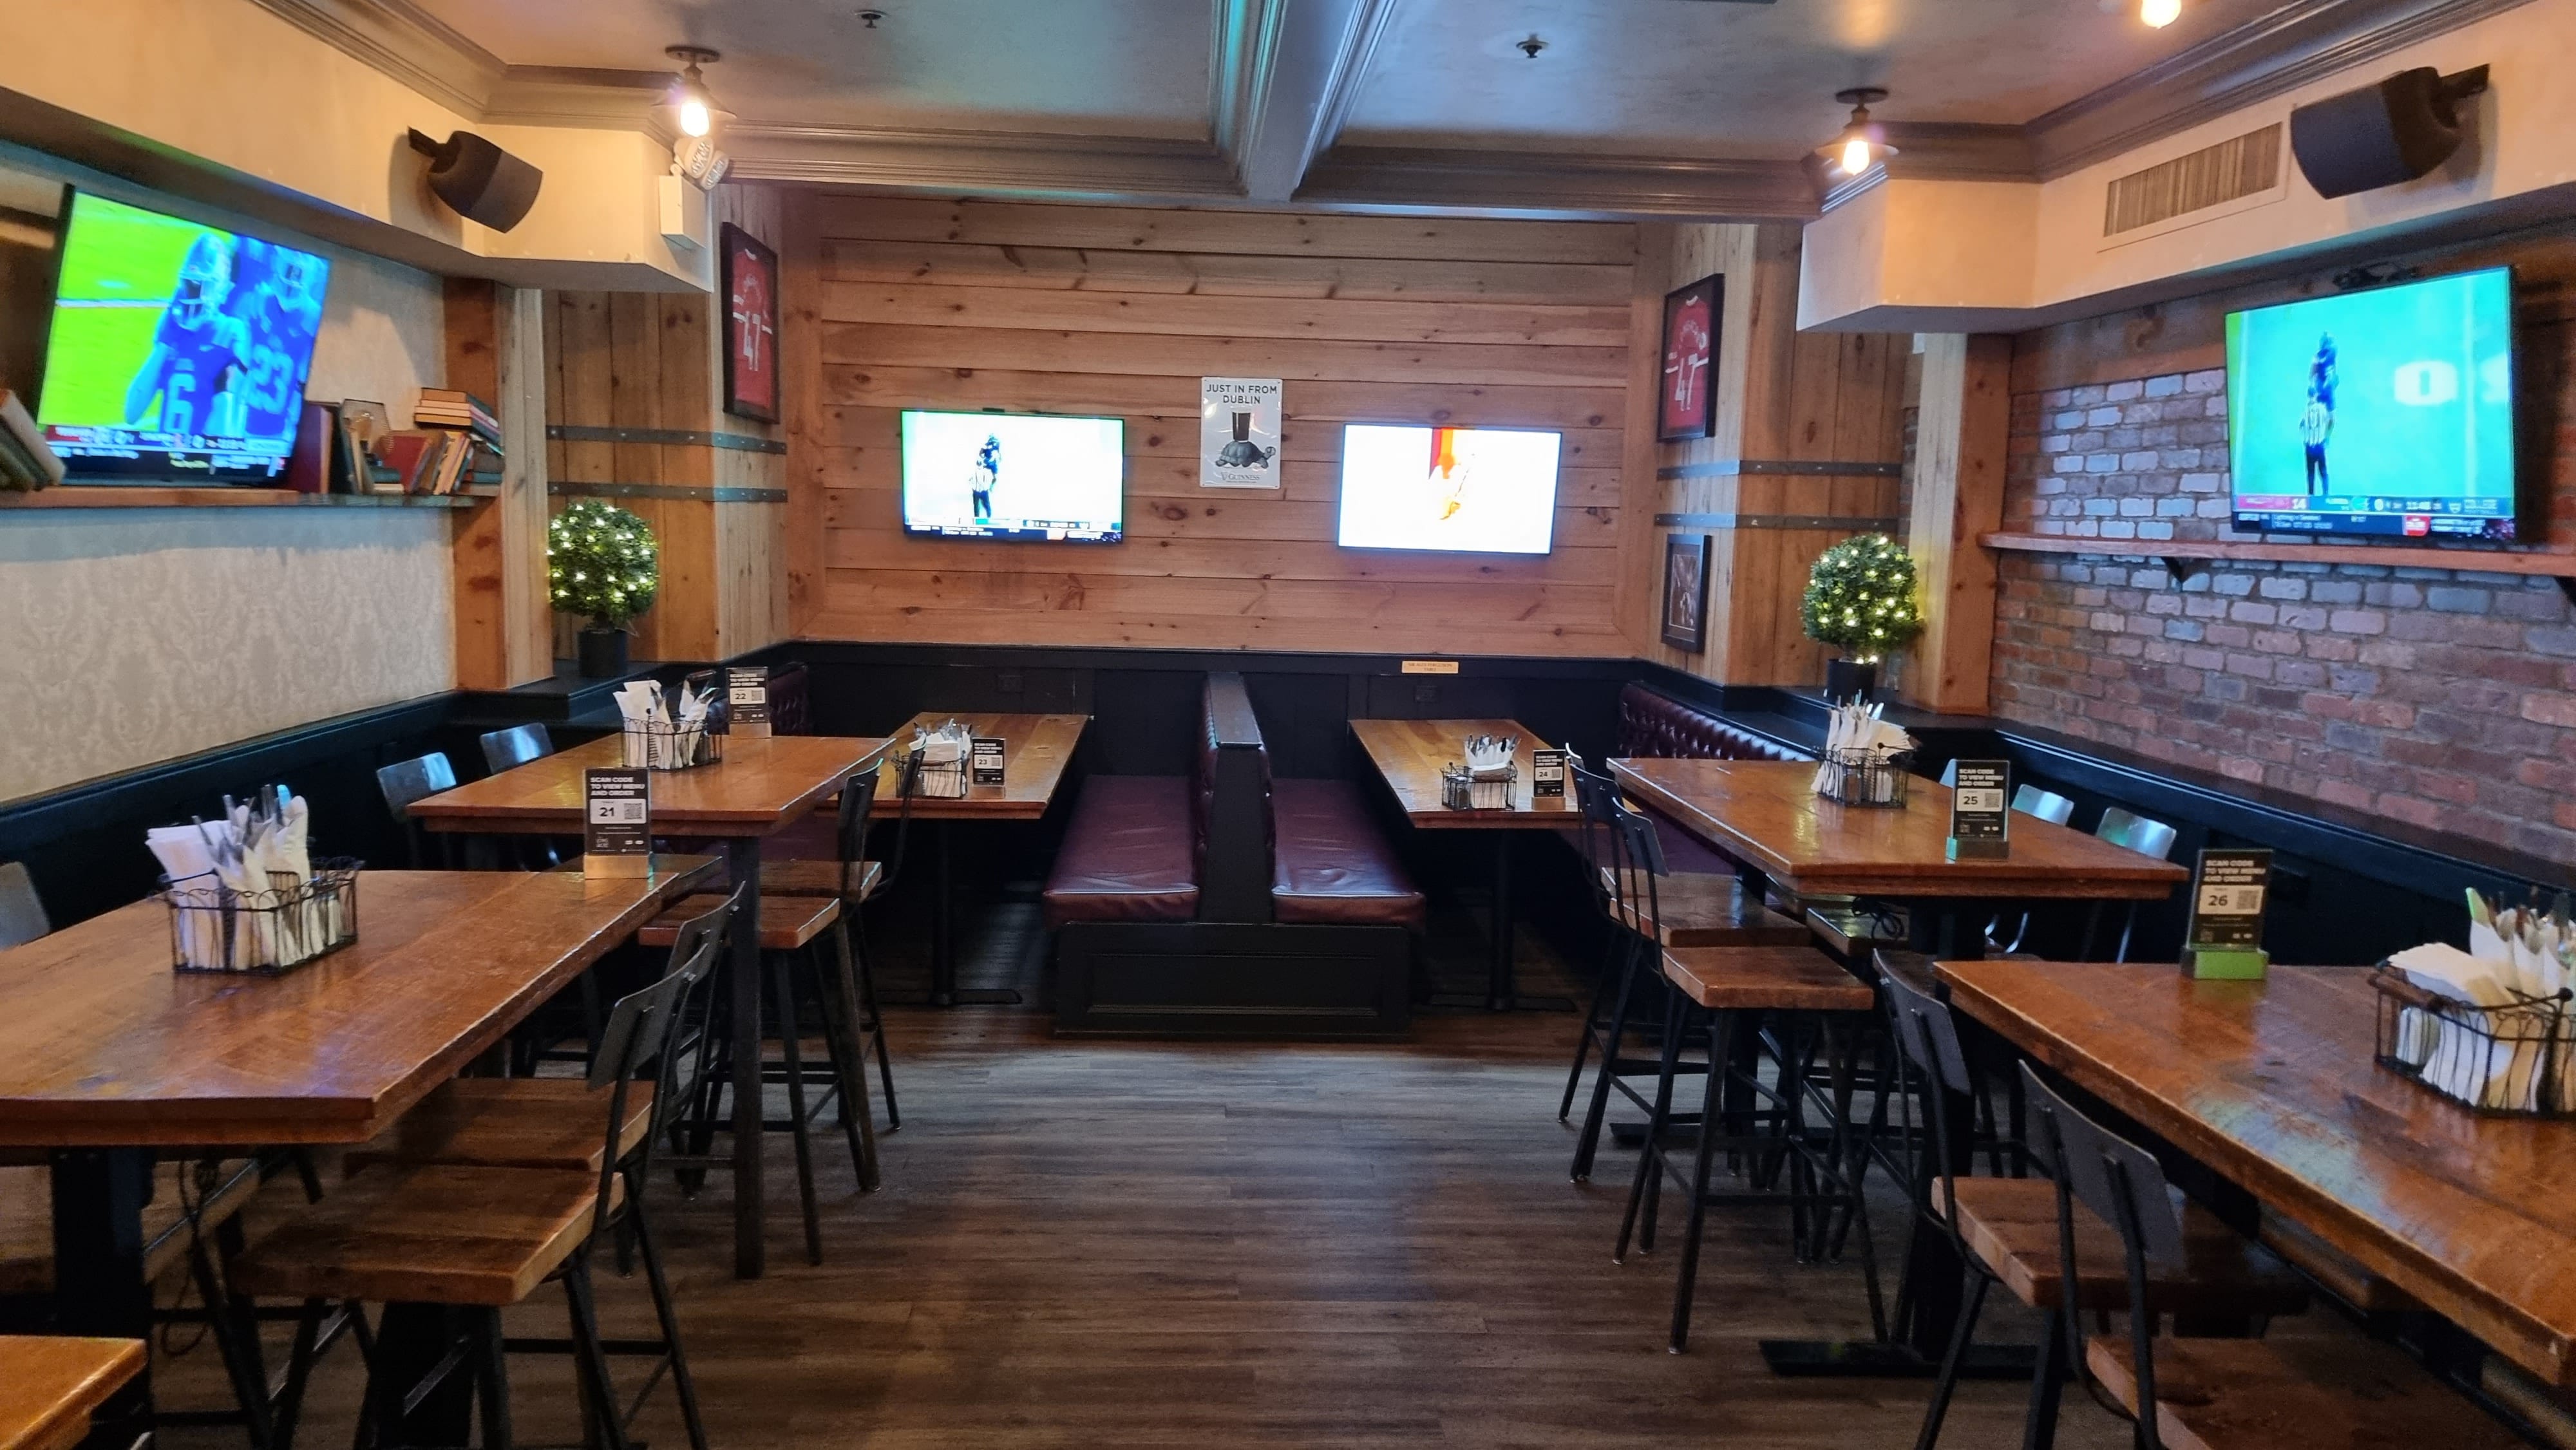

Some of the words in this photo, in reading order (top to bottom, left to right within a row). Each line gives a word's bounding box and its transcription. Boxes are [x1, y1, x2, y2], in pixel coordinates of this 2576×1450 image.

[1206, 384, 1231, 393] JUST
[1235, 385, 1245, 393] IN
[1248, 386, 1277, 394] FROM
[163, 373, 196, 433] 6
[1223, 395, 1260, 404] DUBLIN
[1964, 796, 1978, 805] 25
[599, 807, 615, 817] 21
[2208, 895, 2228, 907] 26
